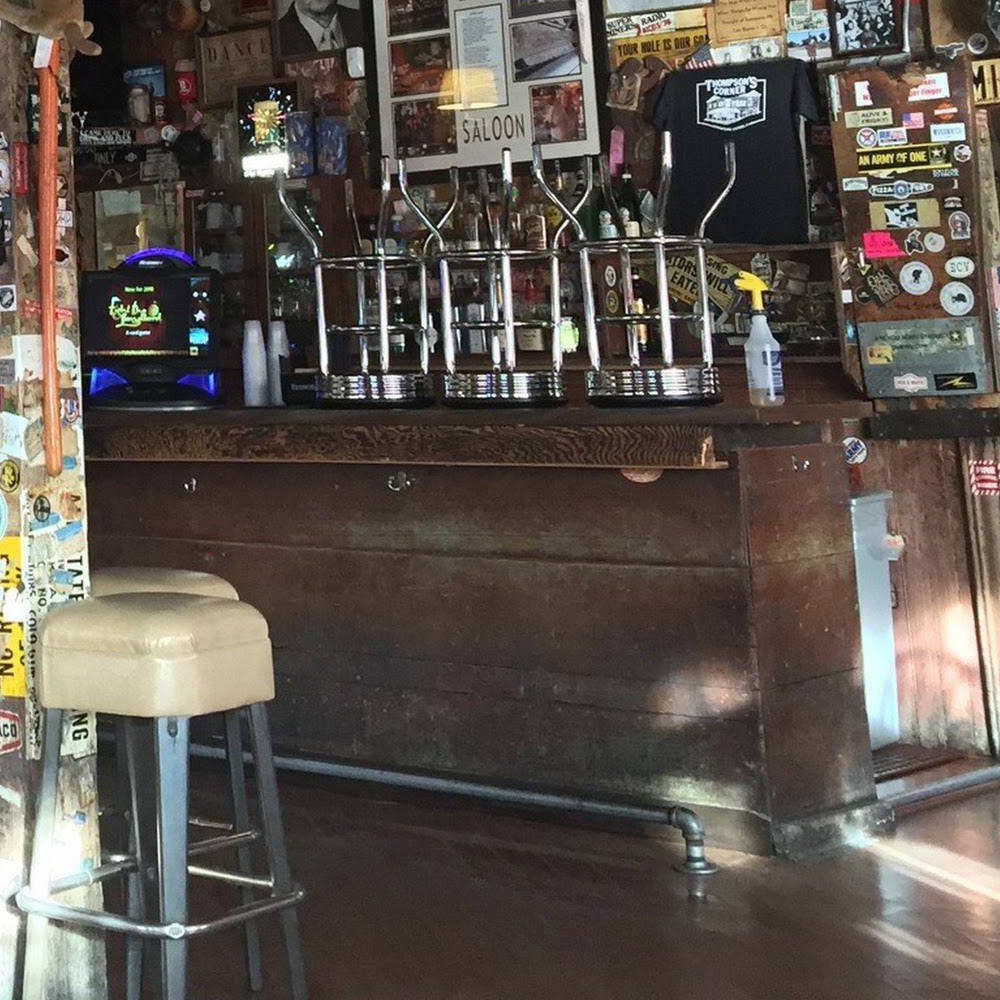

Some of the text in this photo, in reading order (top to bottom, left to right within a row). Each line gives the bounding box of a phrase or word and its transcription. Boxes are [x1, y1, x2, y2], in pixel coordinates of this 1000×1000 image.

[618, 43, 638, 56] YOUR
[641, 40, 660, 53] HOLE
[664, 39, 671, 50] IS
[675, 37, 690, 49] OUR
[705, 76, 758, 92] THOMPSON'S
[713, 86, 746, 96] CORNER
[462, 113, 525, 144] SALOON
[859, 151, 927, 166] AN ARMY OF ONE
[872, 186, 893, 194] PIZZA
[951, 262, 970, 273] ECV
[671, 271, 700, 296] EATE
[846, 440, 863, 460] ARMY
